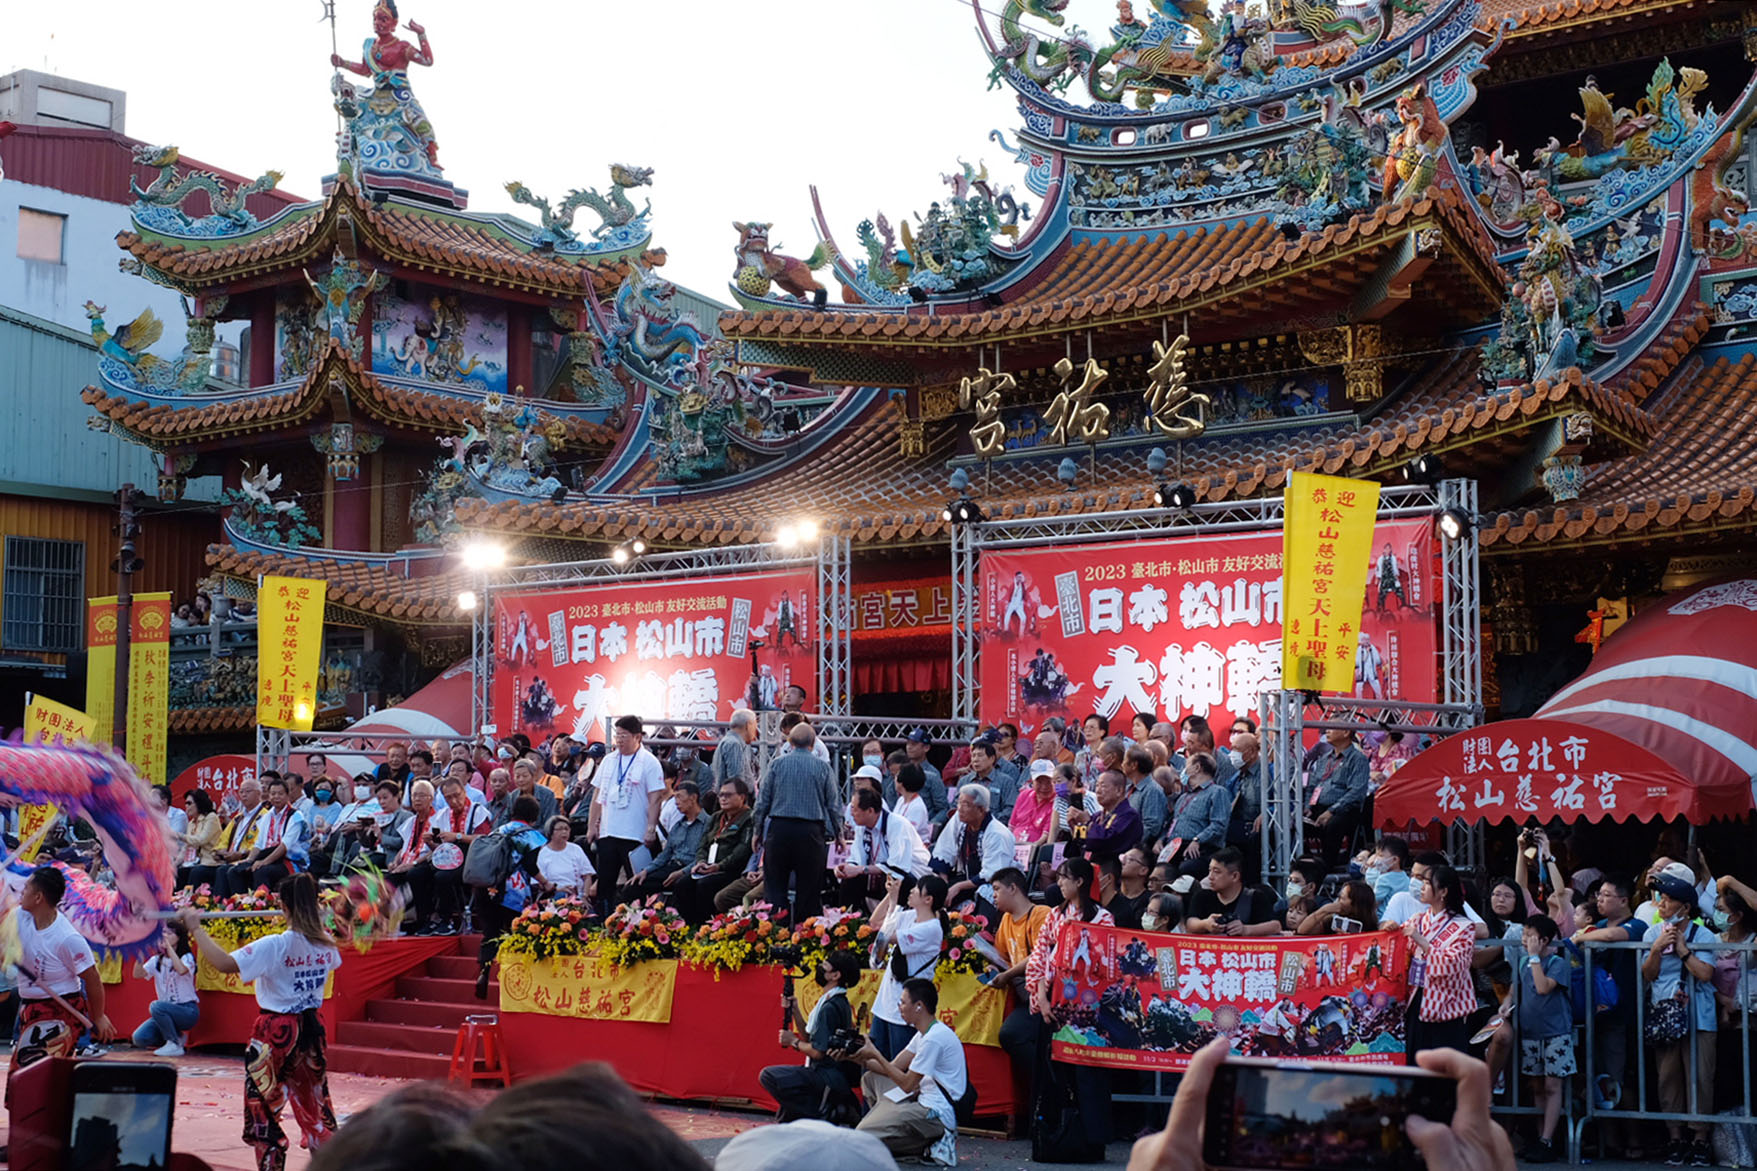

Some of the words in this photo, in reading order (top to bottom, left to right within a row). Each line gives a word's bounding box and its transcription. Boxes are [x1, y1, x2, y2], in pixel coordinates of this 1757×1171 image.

[1085, 564, 1126, 582] 2023
[569, 604, 598, 620] 2023
[666, 596, 727, 613] 友好交流活動
[1089, 584, 1168, 634] 日本
[1306, 508, 1344, 681] 松山慈祐宮天上聖母
[571, 621, 627, 664] 日本
[635, 616, 725, 661] 松山市
[729, 602, 749, 654] 松山市
[1336, 622, 1352, 661] 平安
[278, 600, 302, 722] 松山慈祐宮天上聖母
[37, 707, 85, 738] 財團法人
[1497, 735, 1590, 773] 台北市
[1435, 772, 1623, 814] 松山慈祐宮
[1180, 949, 1217, 967] 日本
[1221, 952, 1276, 969] 松山市
[1280, 953, 1299, 993] 松山市
[533, 985, 636, 1016] 松山慈祐宮
[1178, 967, 1278, 1003] 大神轎
